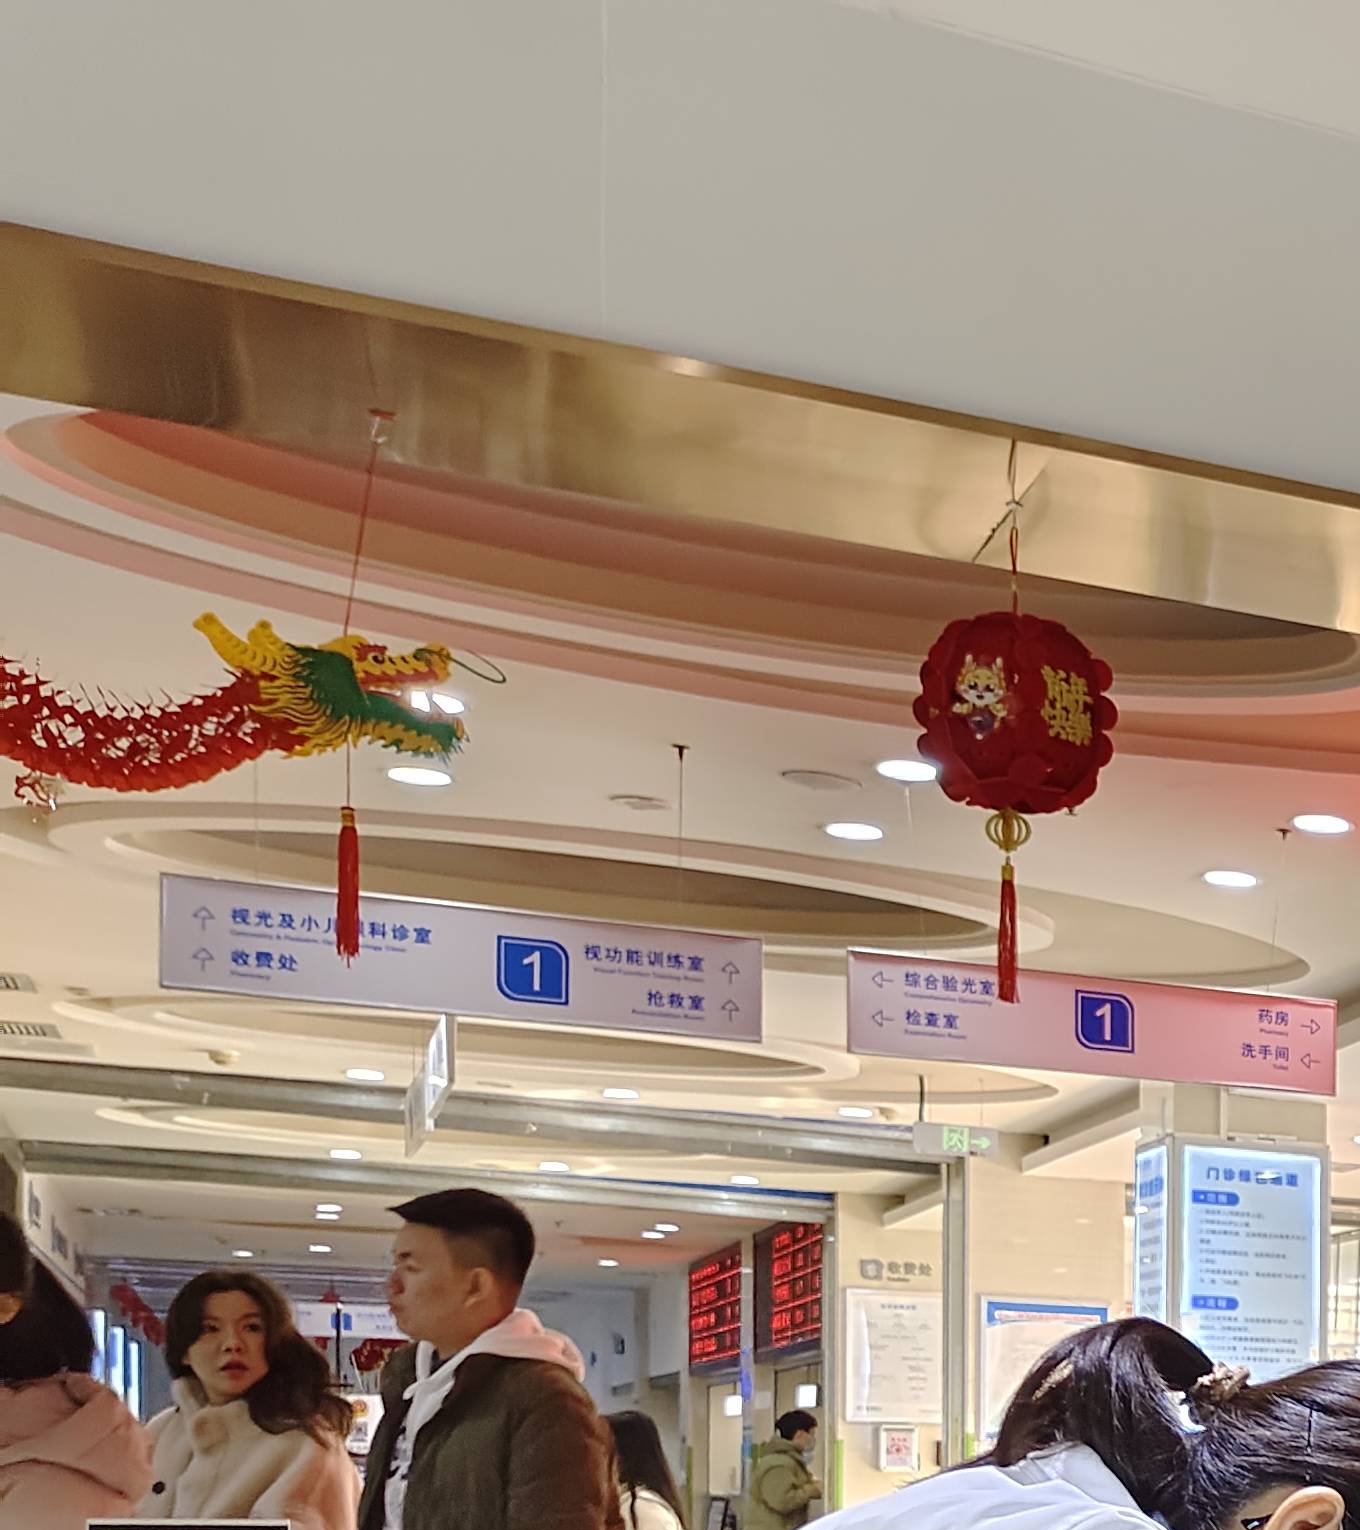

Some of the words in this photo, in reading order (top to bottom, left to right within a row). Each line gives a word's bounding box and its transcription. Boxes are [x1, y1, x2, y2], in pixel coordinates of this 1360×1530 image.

[231, 949, 298, 973] 收费处
[584, 944, 705, 972] 视功能训练室
[522, 949, 541, 992] 1
[904, 971, 995, 996] 综合验光室
[647, 989, 705, 1011] 抢救室
[905, 1009, 959, 1030] 检查室
[1095, 1002, 1112, 1041] 1
[1258, 1008, 1289, 1026] 药房
[1241, 1043, 1289, 1062] 洗手间
